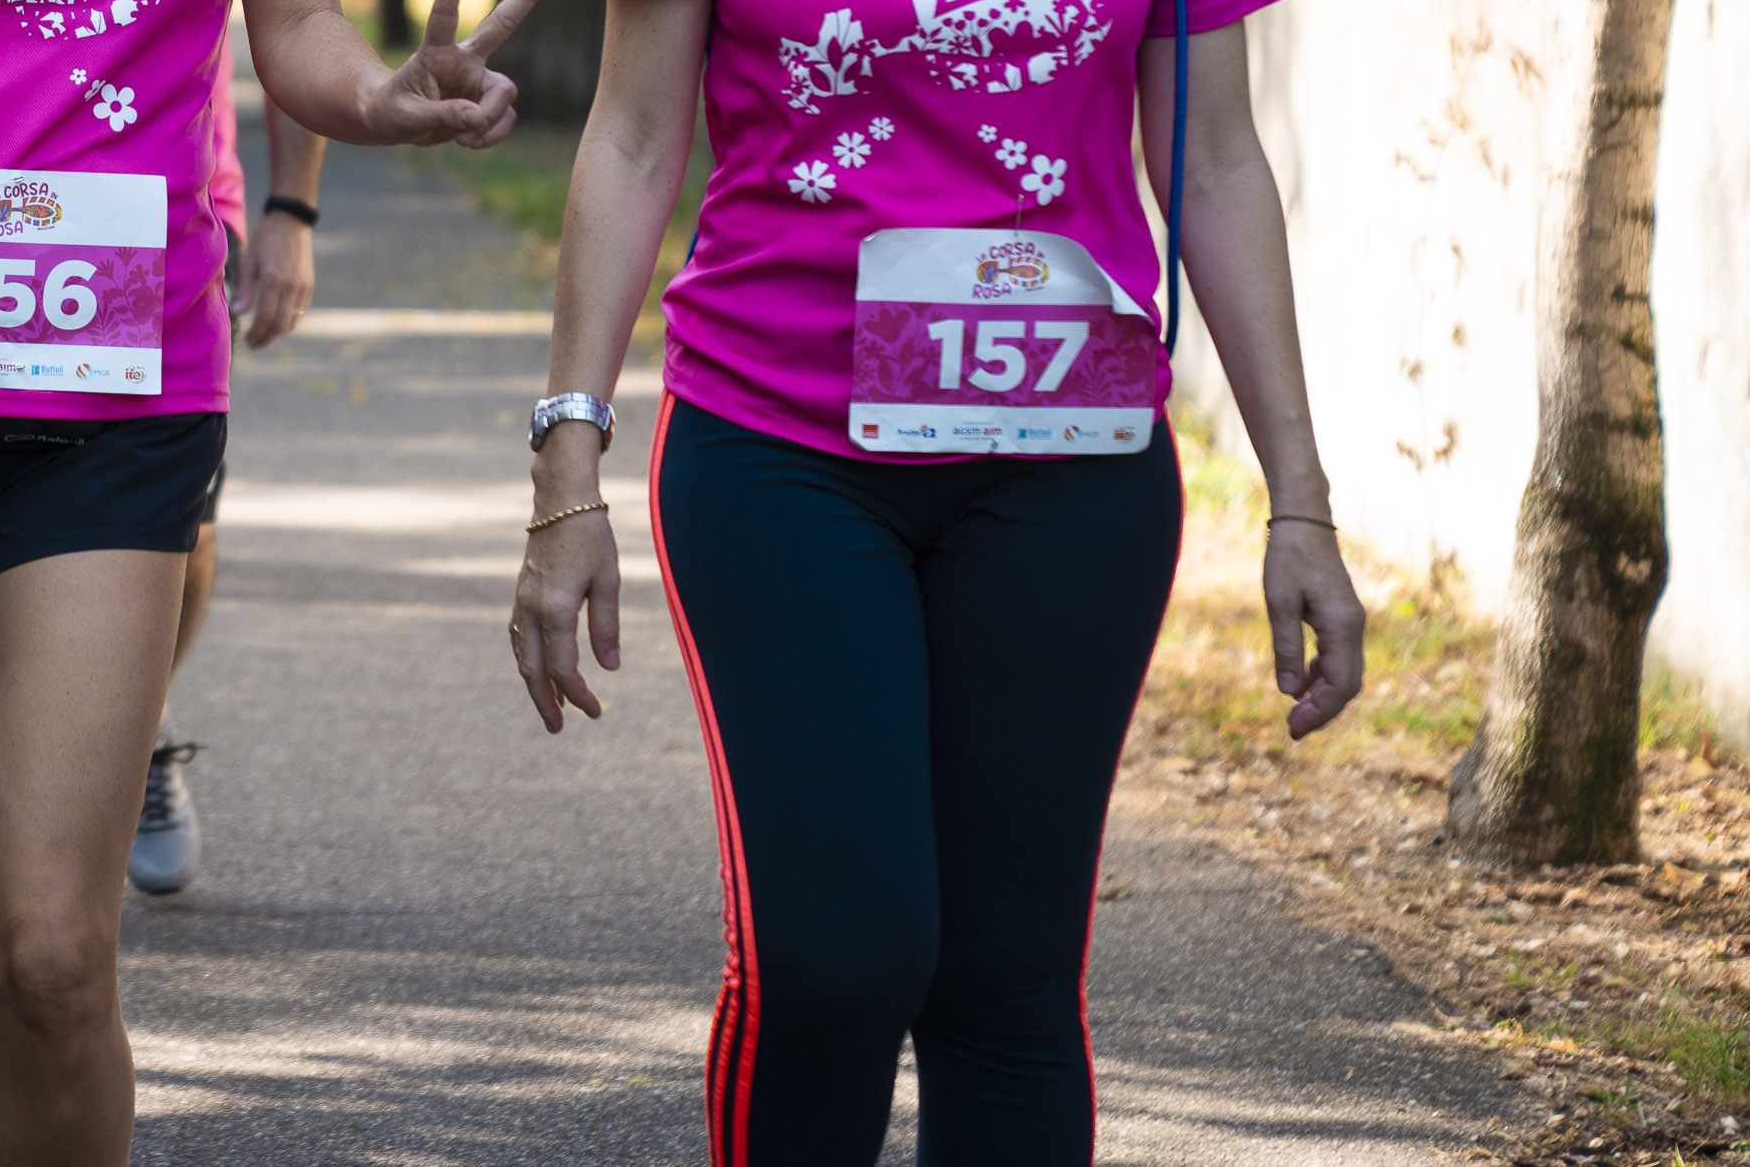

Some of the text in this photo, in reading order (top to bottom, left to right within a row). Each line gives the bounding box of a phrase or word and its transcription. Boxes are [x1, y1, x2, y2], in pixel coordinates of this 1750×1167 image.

[3, 182, 49, 199] CORSA
[50, 191, 59, 200] IN
[989, 242, 1035, 259] CORSA
[971, 282, 1012, 299] ROSA
[927, 319, 1090, 393] 157
